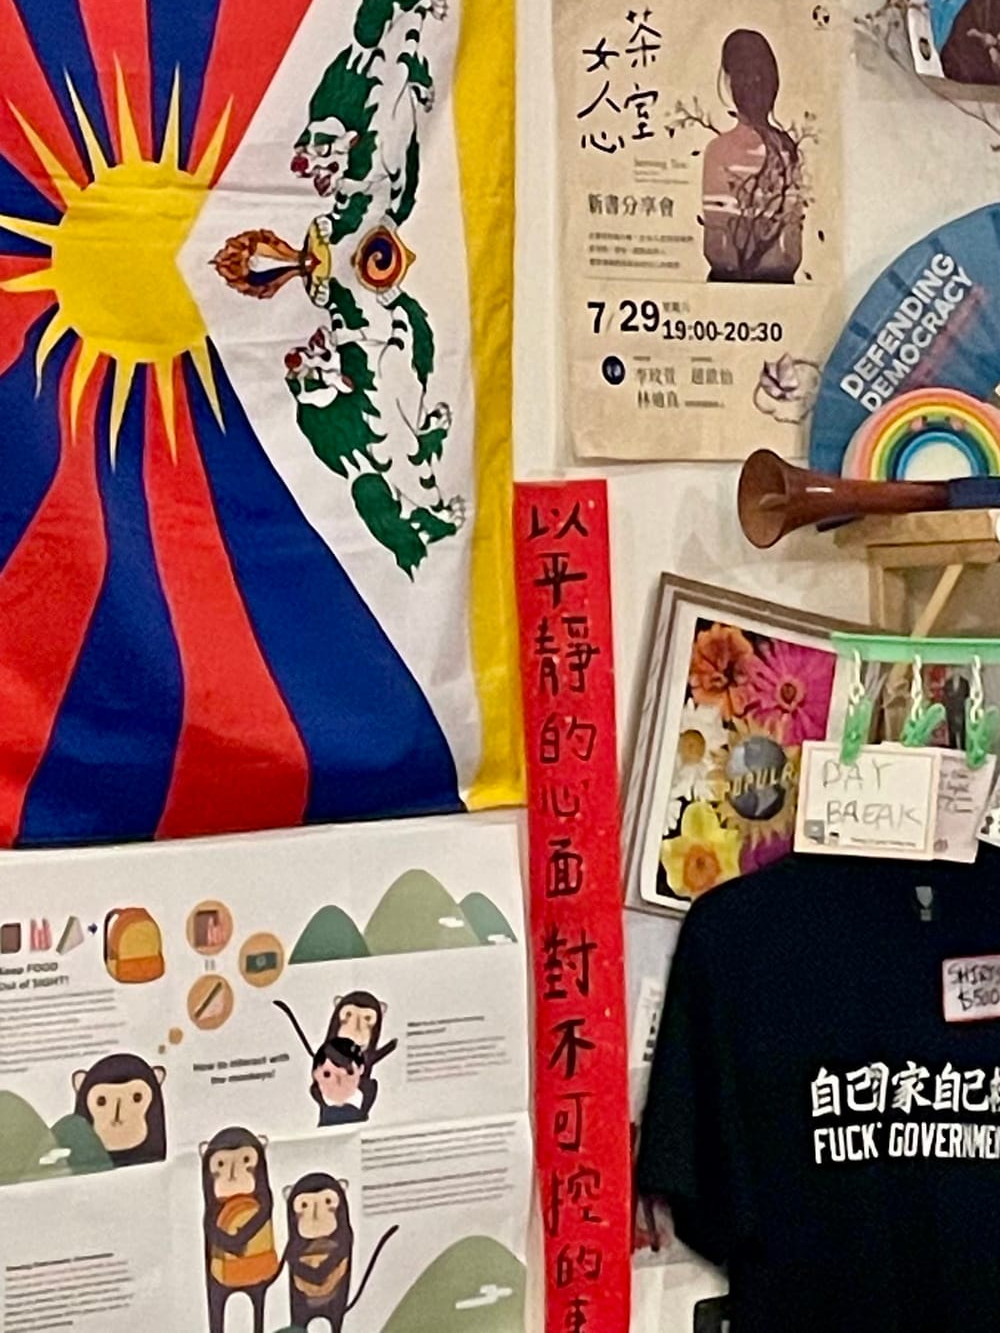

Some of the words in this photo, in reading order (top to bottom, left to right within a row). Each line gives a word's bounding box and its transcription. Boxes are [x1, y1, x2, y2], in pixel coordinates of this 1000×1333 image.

[662, 319, 783, 342] 19:00-20:30
[840, 253, 955, 400] DEFENDING
[860, 266, 972, 413] DEMOCRACY
[822, 758, 893, 791] DAY
[813, 1123, 880, 1164] FUCK
